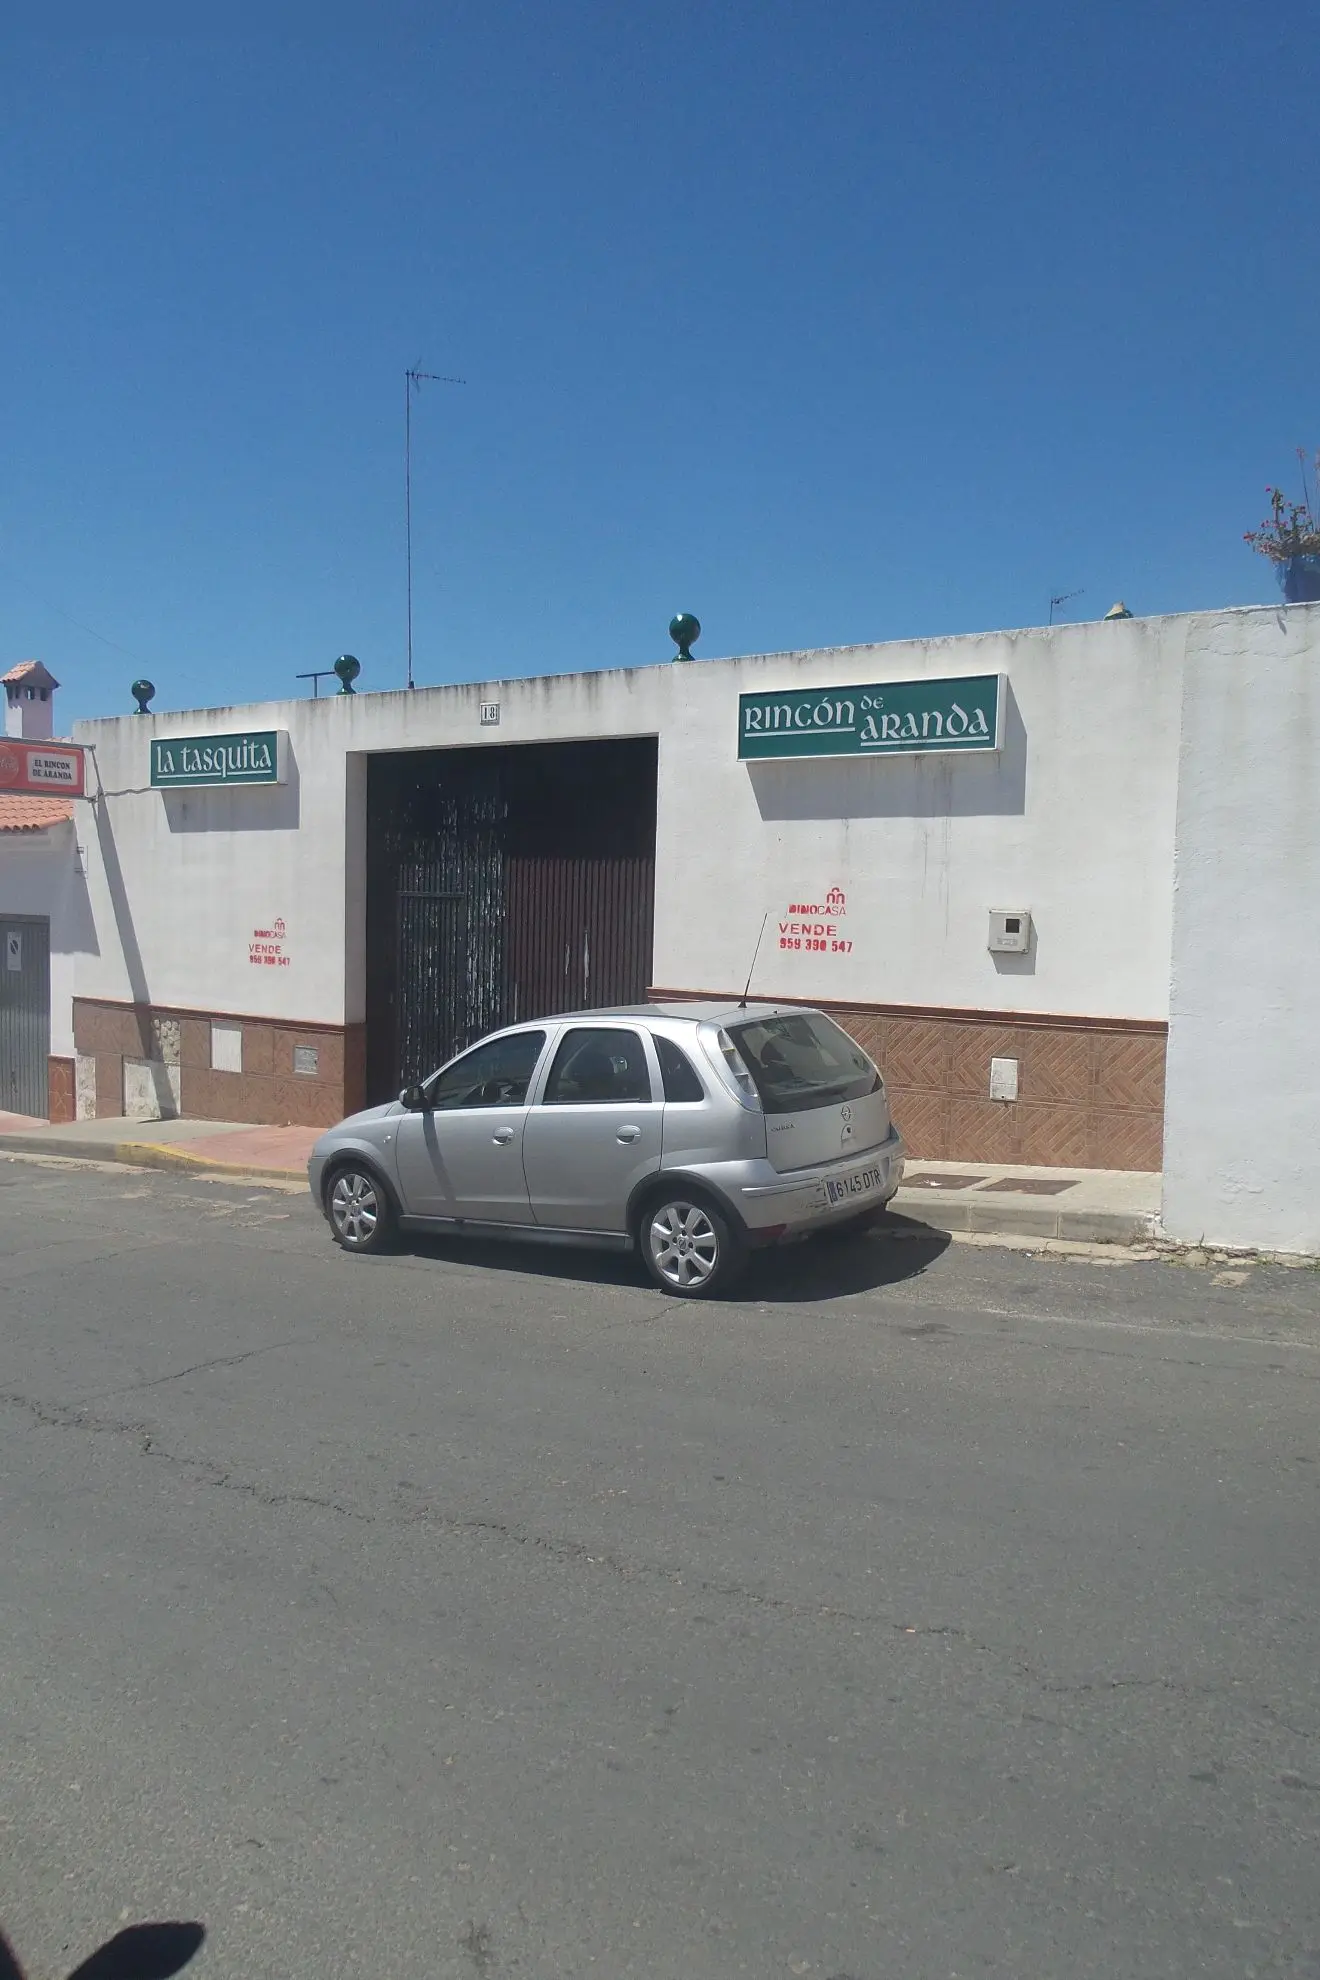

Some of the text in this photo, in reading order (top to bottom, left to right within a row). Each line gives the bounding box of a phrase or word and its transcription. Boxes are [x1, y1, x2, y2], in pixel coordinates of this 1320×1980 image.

[484, 706, 495, 720] 18
[34, 759, 70, 770] EL RINCON
[33, 769, 72, 780] DE ARANDA
[779, 923, 837, 936] VENDE
[248, 943, 281, 954] VENDE
[779, 937, 801, 950] 959
[831, 940, 853, 953] 547
[836, 1168, 881, 1198] 6145 DTR
